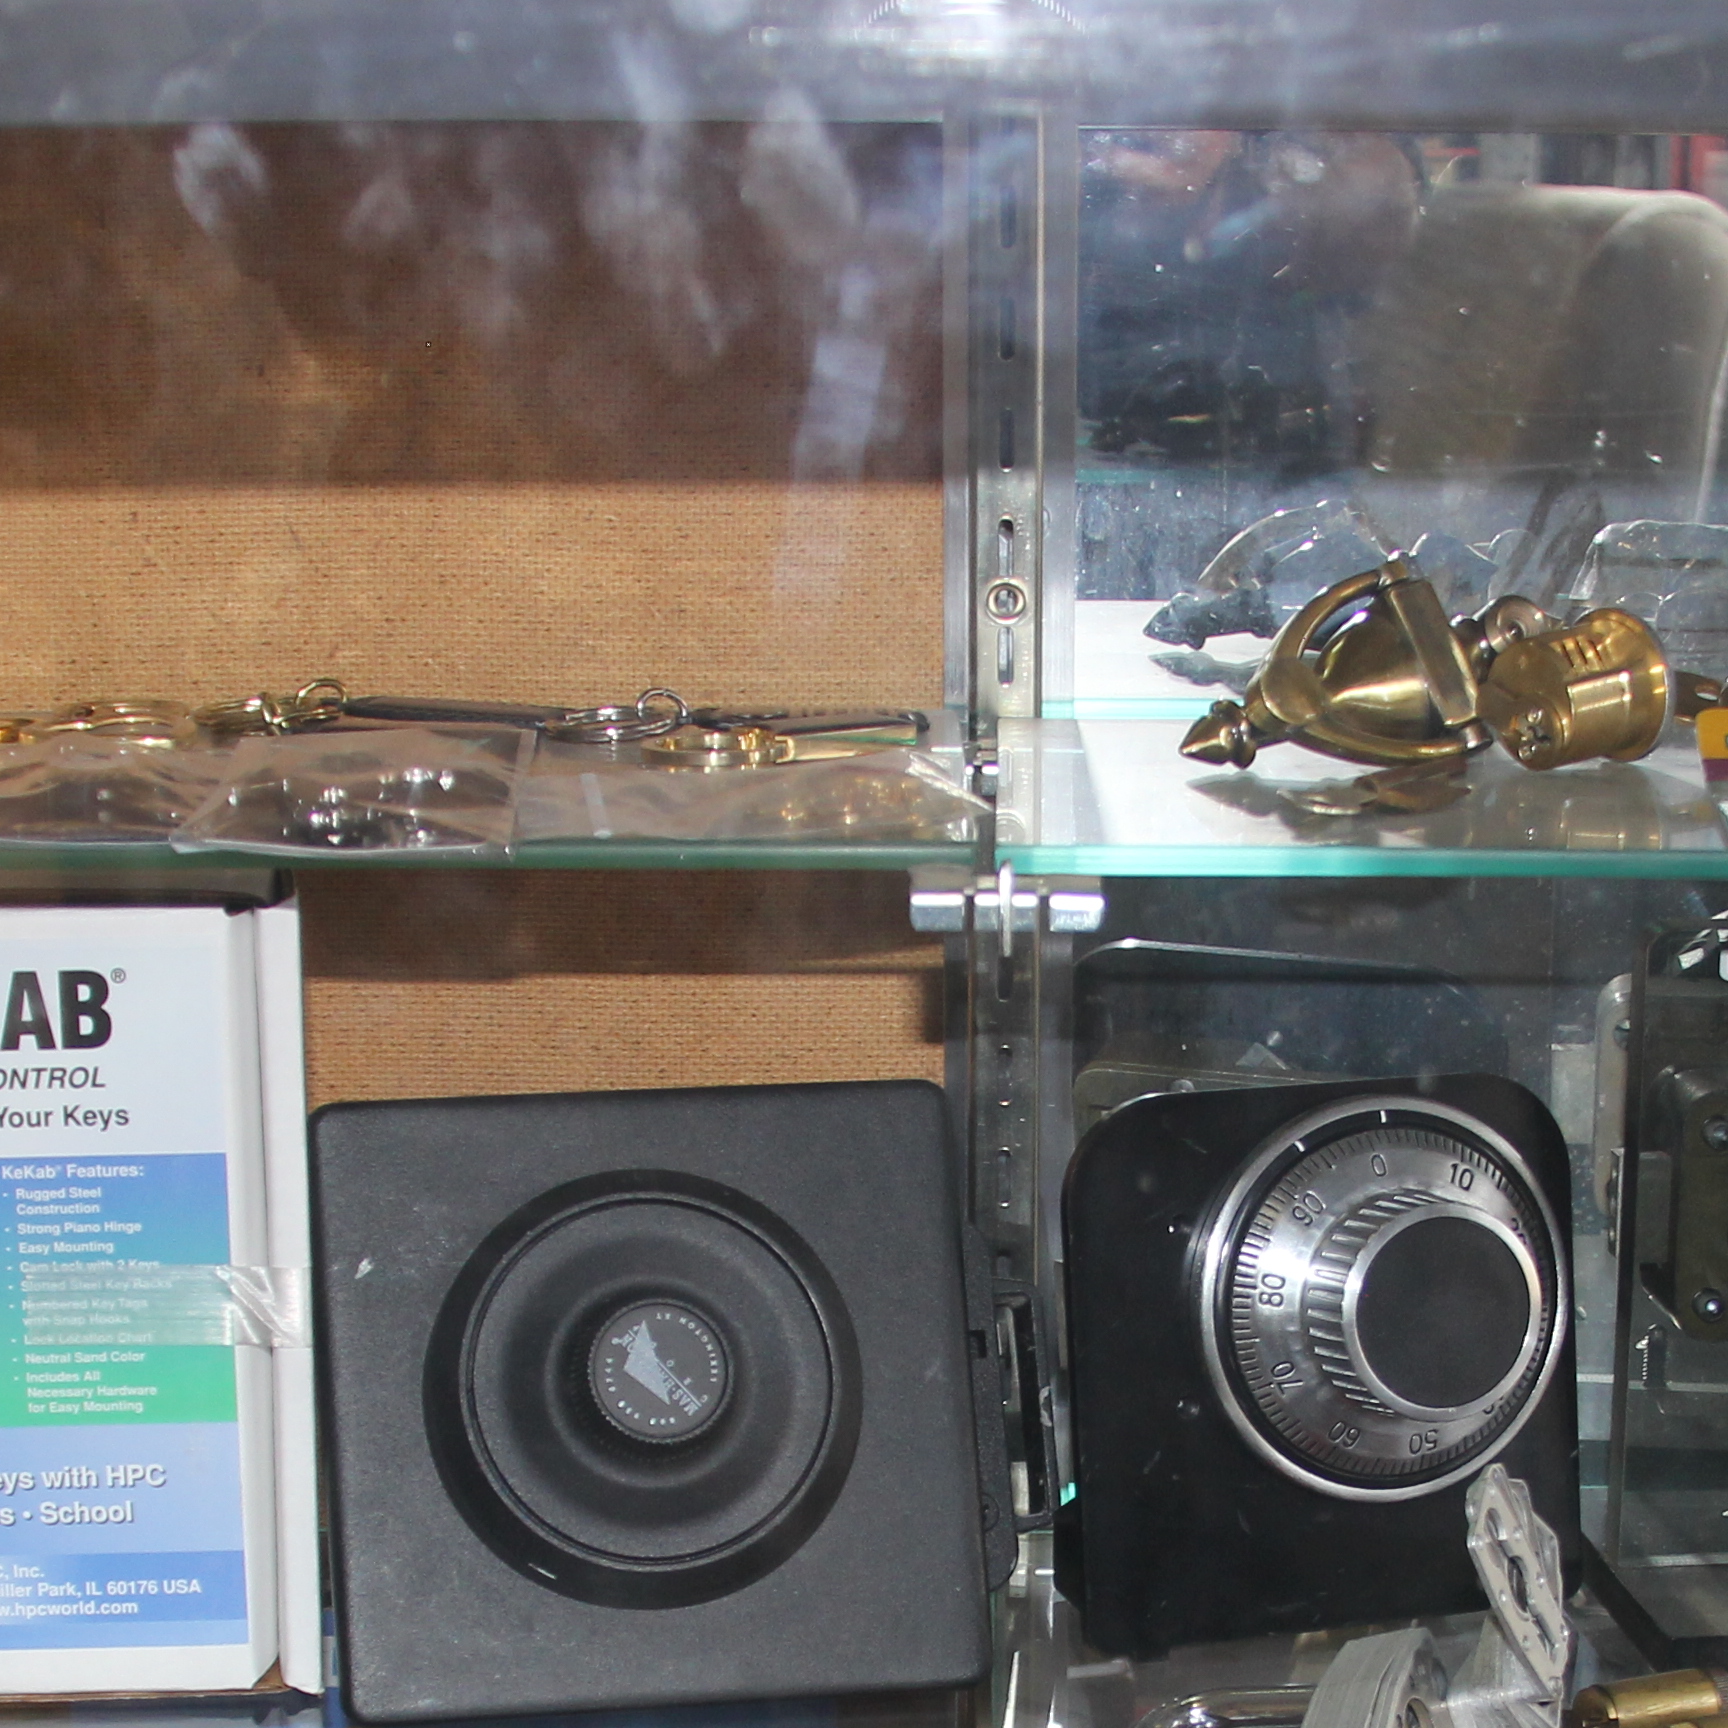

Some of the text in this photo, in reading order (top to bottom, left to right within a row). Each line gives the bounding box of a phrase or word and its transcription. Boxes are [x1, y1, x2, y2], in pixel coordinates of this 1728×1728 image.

[63, 1104, 129, 1132] Keys
[66, 1164, 144, 1178] Features:
[16, 1187, 102, 1200] Rugged Steel
[16, 1203, 100, 1215] Construction
[18, 1222, 142, 1236] Strong Piano Hinge
[19, 1241, 114, 1254] Easy Mounting
[25, 1352, 145, 1364] Neutral Sand Color
[42, 1467, 98, 1489] with
[105, 1464, 166, 1488] HPC
[40, 1501, 133, 1524] School
[13, 1565, 44, 1579] Inc.
[38, 1583, 81, 1598] Park,
[86, 1582, 102, 1596] IL
[107, 1581, 157, 1595] 60176
[163, 1580, 201, 1594] USA
